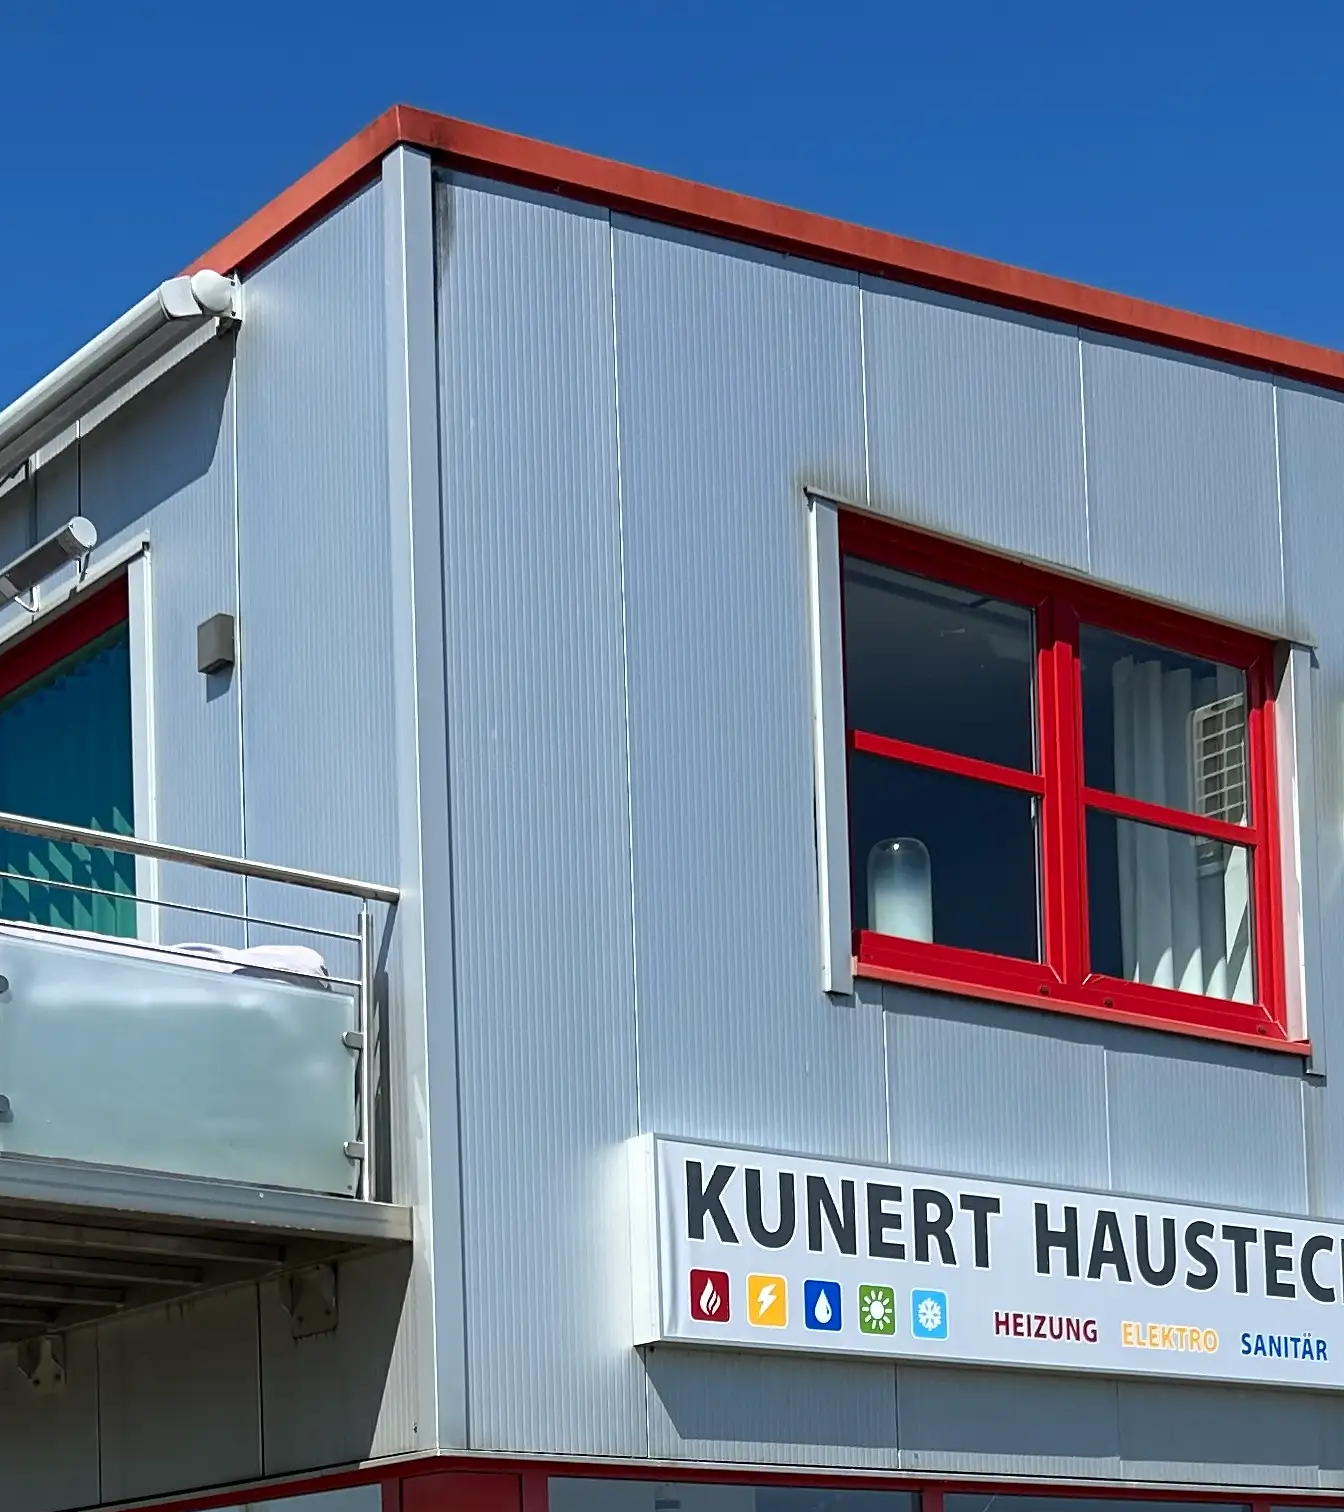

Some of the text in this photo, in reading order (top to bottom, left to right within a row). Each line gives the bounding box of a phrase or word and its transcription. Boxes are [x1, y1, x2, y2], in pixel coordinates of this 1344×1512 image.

[684, 1160, 1001, 1269] KUNERT
[994, 1311, 1099, 1345] HEIZUNG
[1122, 1321, 1219, 1354] ELEKTRO
[1241, 1331, 1329, 1363] SANITÄR
